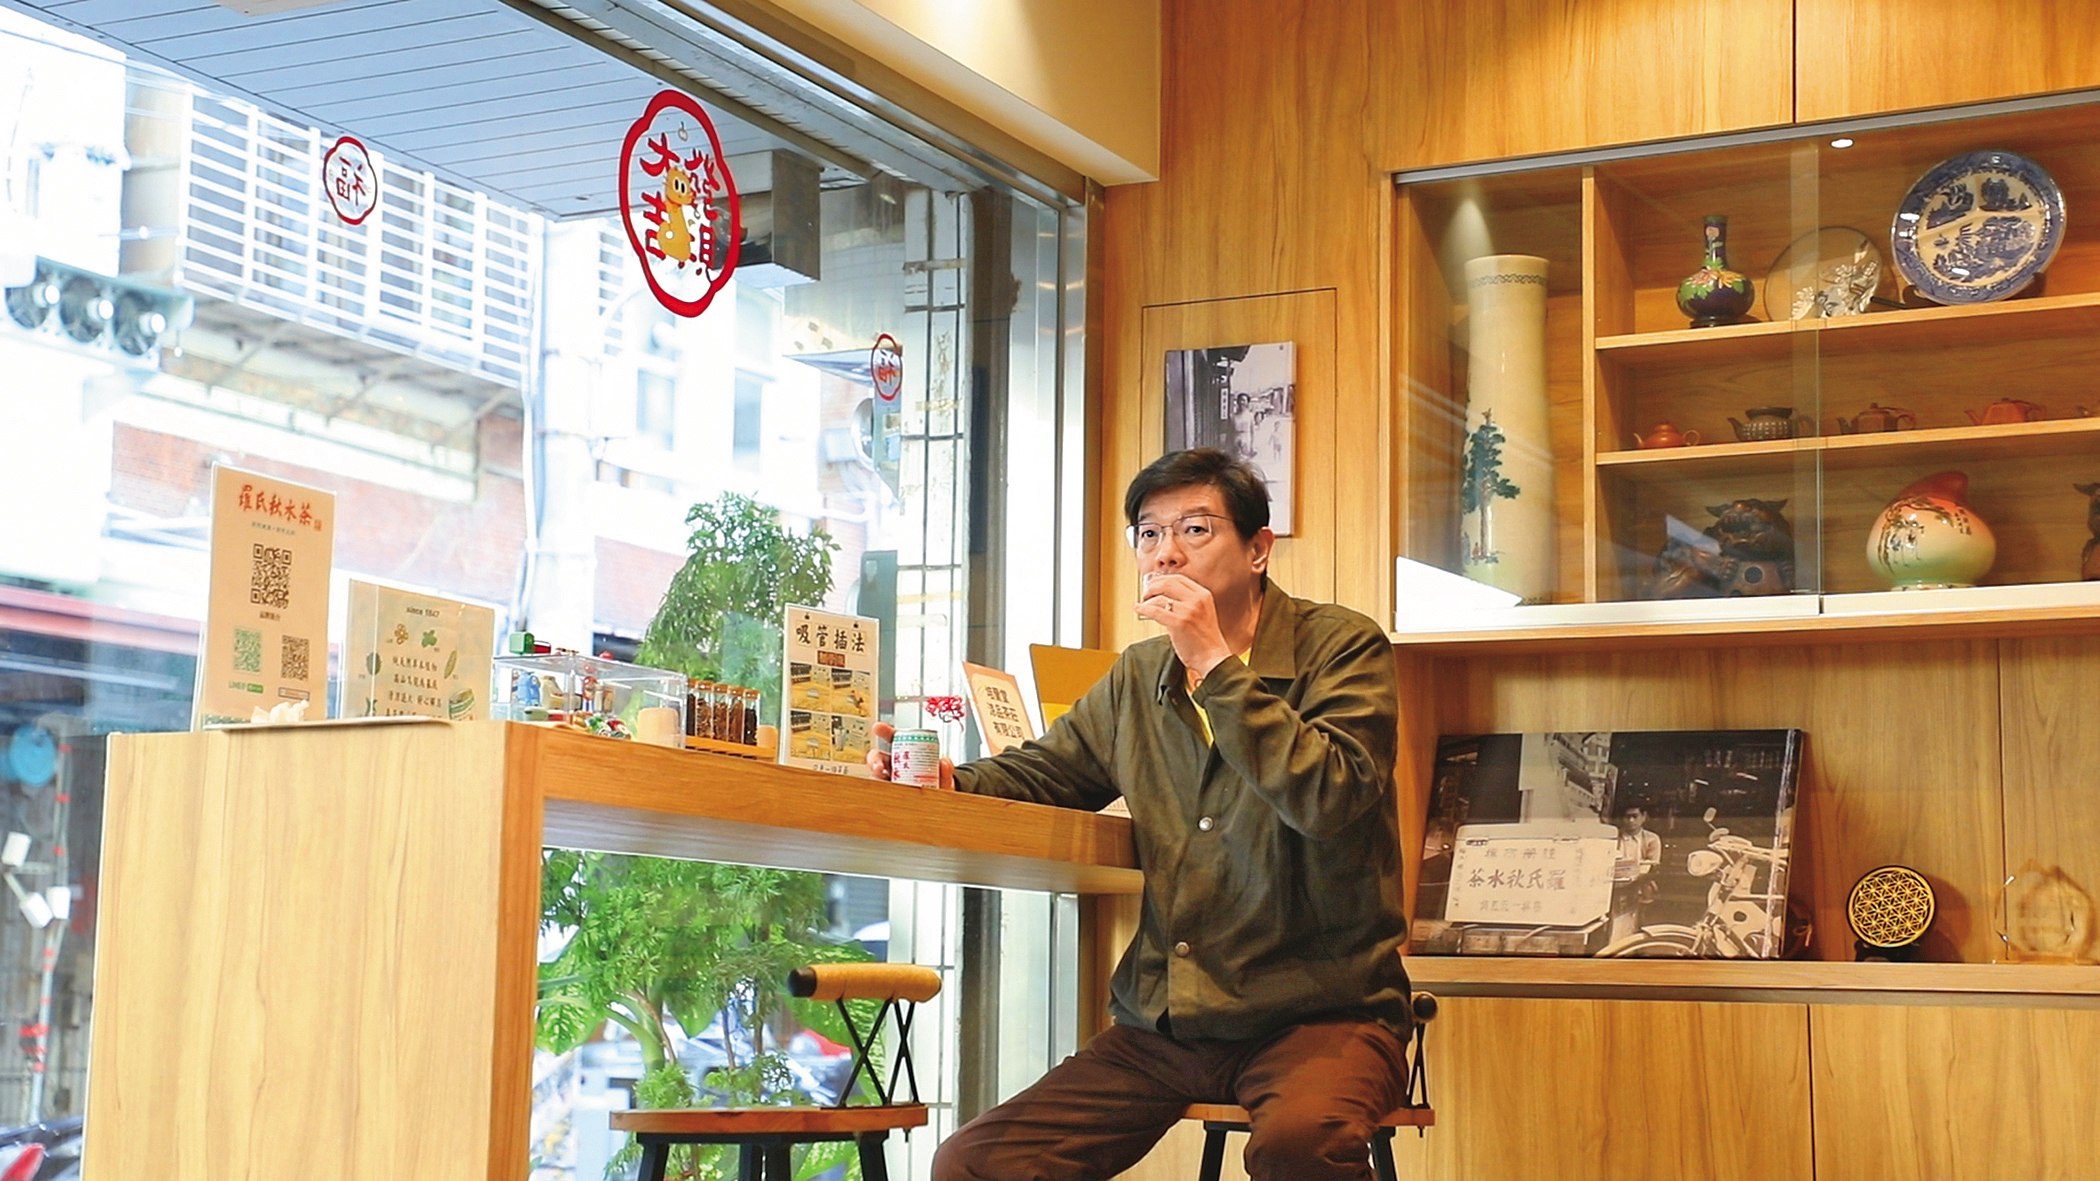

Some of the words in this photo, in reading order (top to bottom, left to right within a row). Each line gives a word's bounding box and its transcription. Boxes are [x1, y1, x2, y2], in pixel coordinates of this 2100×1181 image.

[239, 484, 312, 526] 羅氏秋水茶
[796, 624, 865, 653] 吸管插法
[993, 721, 1025, 740] 有限公司
